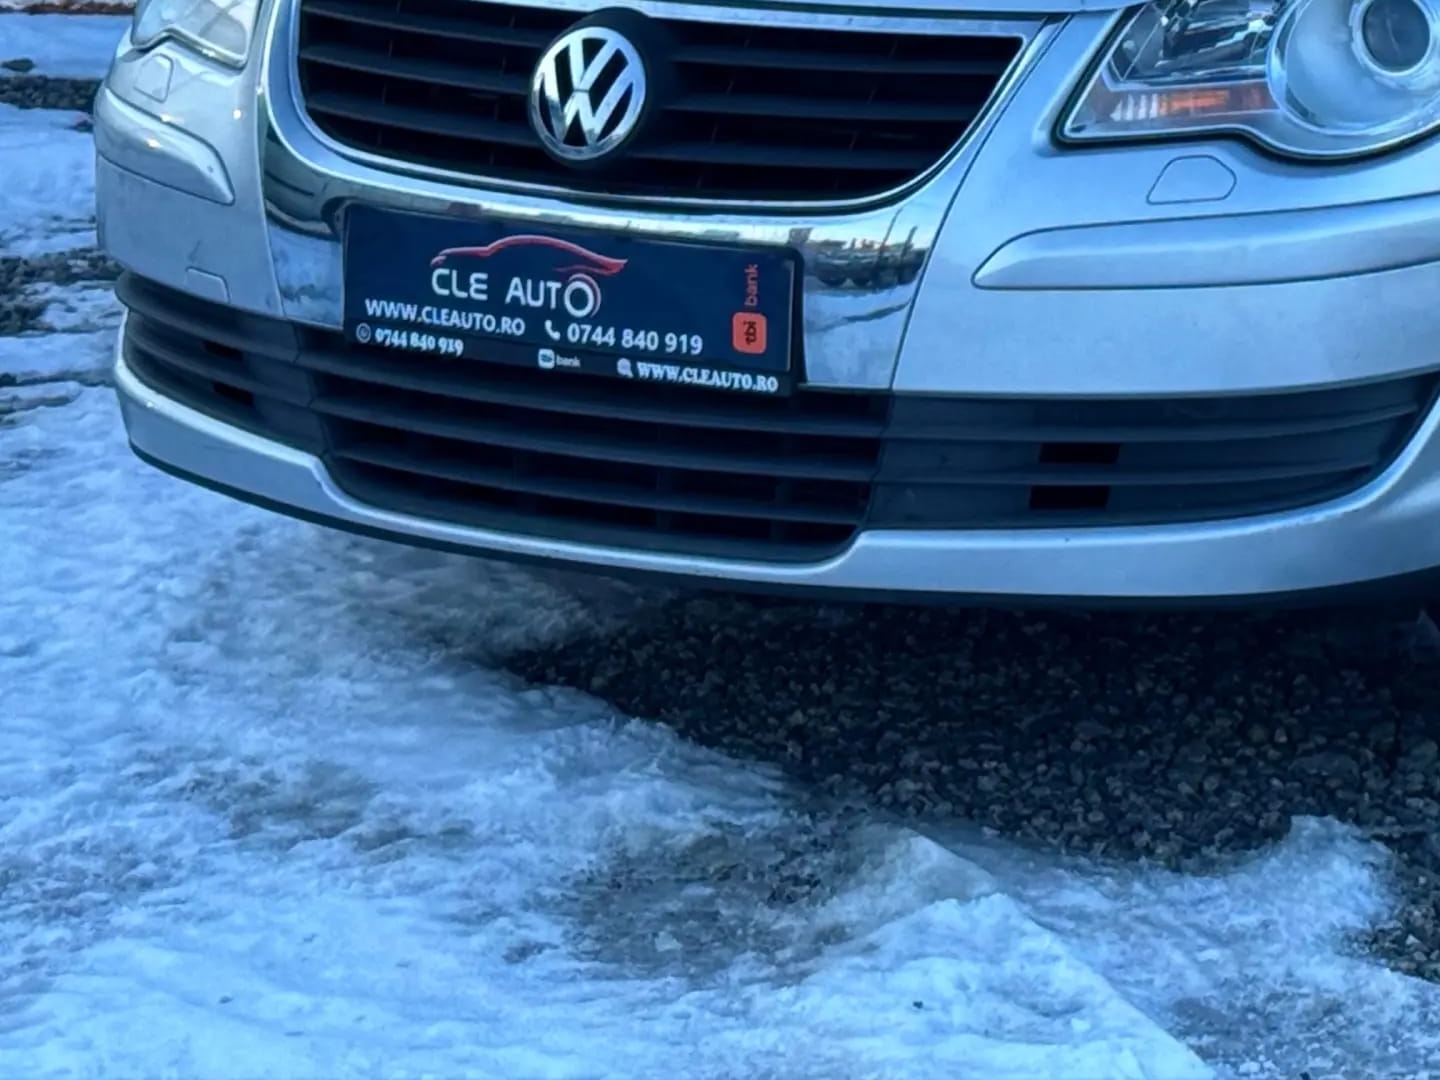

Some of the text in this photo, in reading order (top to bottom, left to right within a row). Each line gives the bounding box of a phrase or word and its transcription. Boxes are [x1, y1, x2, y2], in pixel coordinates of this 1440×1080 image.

[533, 26, 646, 160] VW
[431, 268, 597, 318] CLE AUTO
[744, 263, 759, 307] bank
[365, 298, 526, 336] WWW.CLEAUTO.RO
[375, 327, 465, 357] 0744 840 919
[567, 322, 704, 356] 0744 840 919
[636, 361, 778, 393] WWW.CLEAUTO.RO
